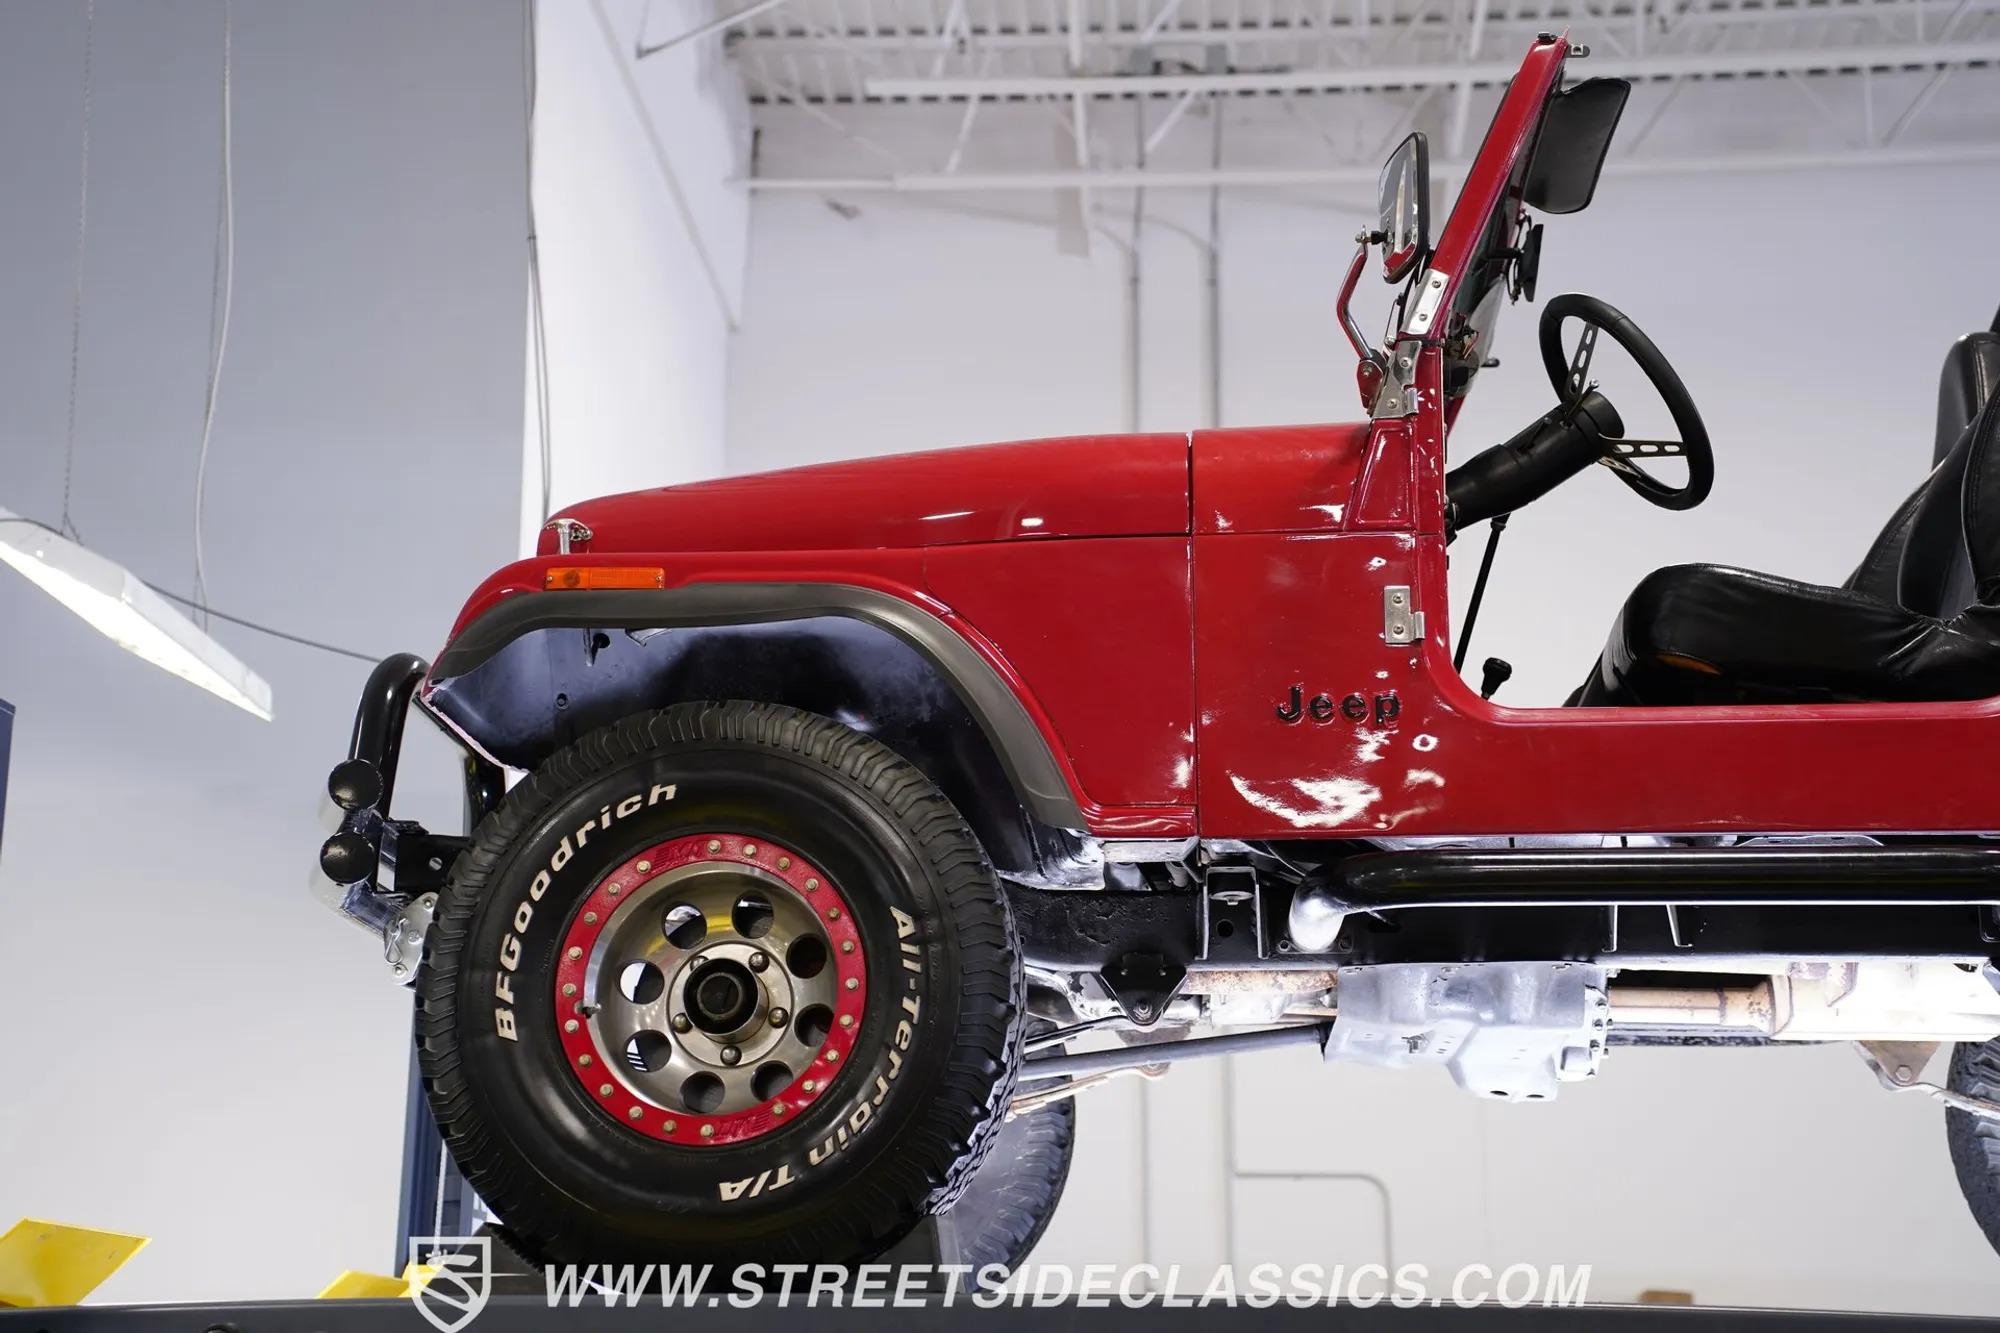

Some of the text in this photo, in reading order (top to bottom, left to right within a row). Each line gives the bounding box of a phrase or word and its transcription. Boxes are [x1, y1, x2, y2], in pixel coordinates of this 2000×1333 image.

[1276, 684, 1401, 724] Jeep
[495, 784, 677, 1041] BFGoodrich
[809, 906, 922, 1167] All-Terrain
[719, 1164, 796, 1202] T/A
